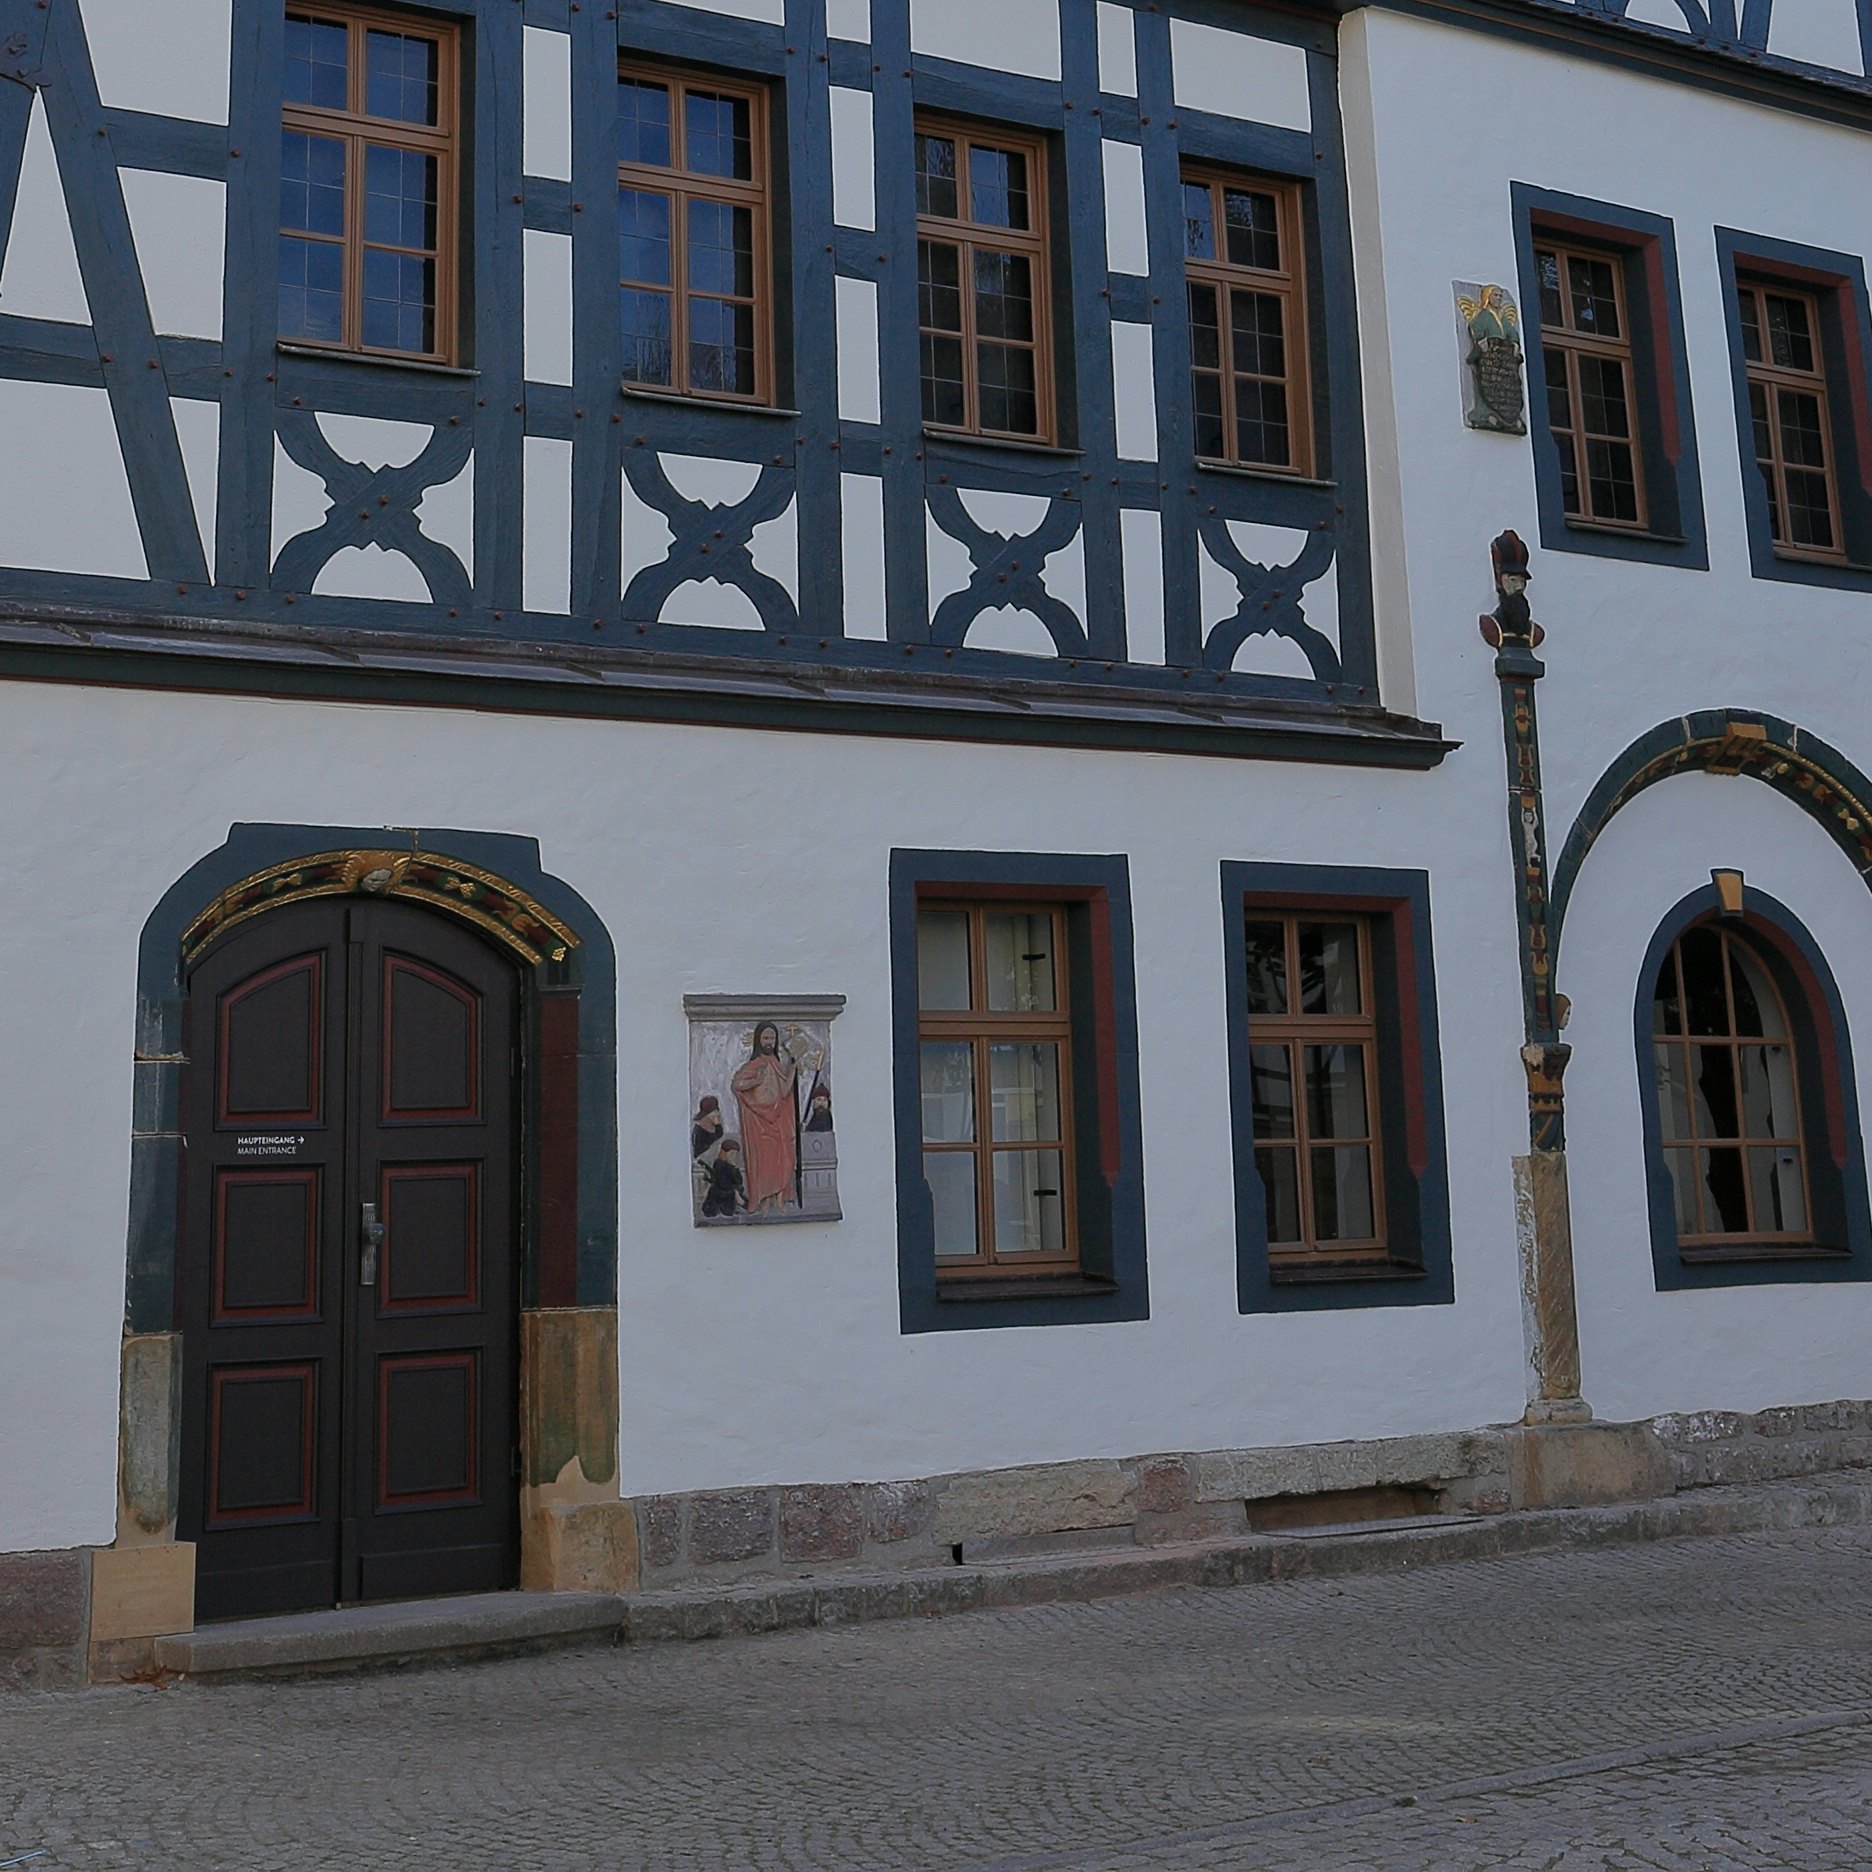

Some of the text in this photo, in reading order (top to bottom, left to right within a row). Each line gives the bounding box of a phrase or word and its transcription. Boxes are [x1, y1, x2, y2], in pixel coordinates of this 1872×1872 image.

[237, 1136, 295, 1145] HAUPTEINGANG
[237, 1146, 297, 1155] MAIN ENTRANCE
